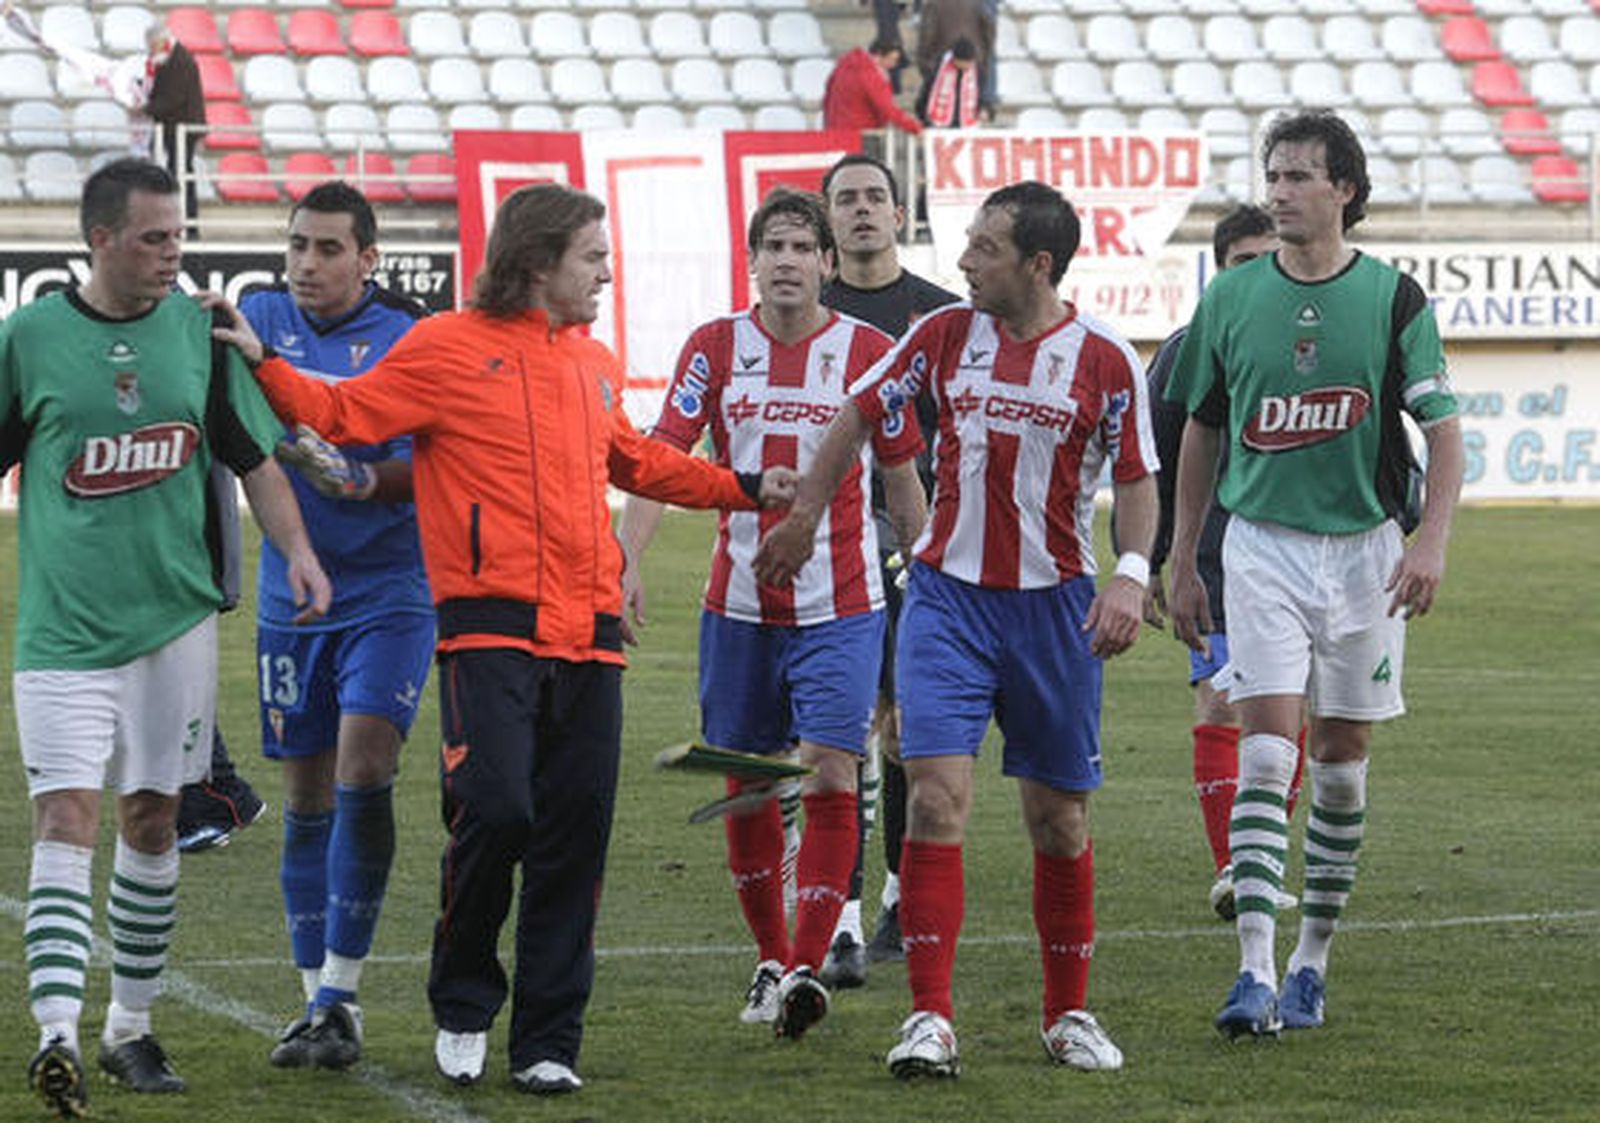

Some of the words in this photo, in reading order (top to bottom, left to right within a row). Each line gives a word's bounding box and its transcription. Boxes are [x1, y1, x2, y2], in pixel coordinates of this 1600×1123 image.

[932, 135, 1201, 190] KOMANDO
[397, 271, 448, 293] 167
[985, 395, 1072, 433] CEPSA
[1259, 394, 1352, 432] Dhul
[83, 429, 184, 475] Dhul
[260, 653, 299, 706] 13
[1371, 655, 1392, 685] 4
